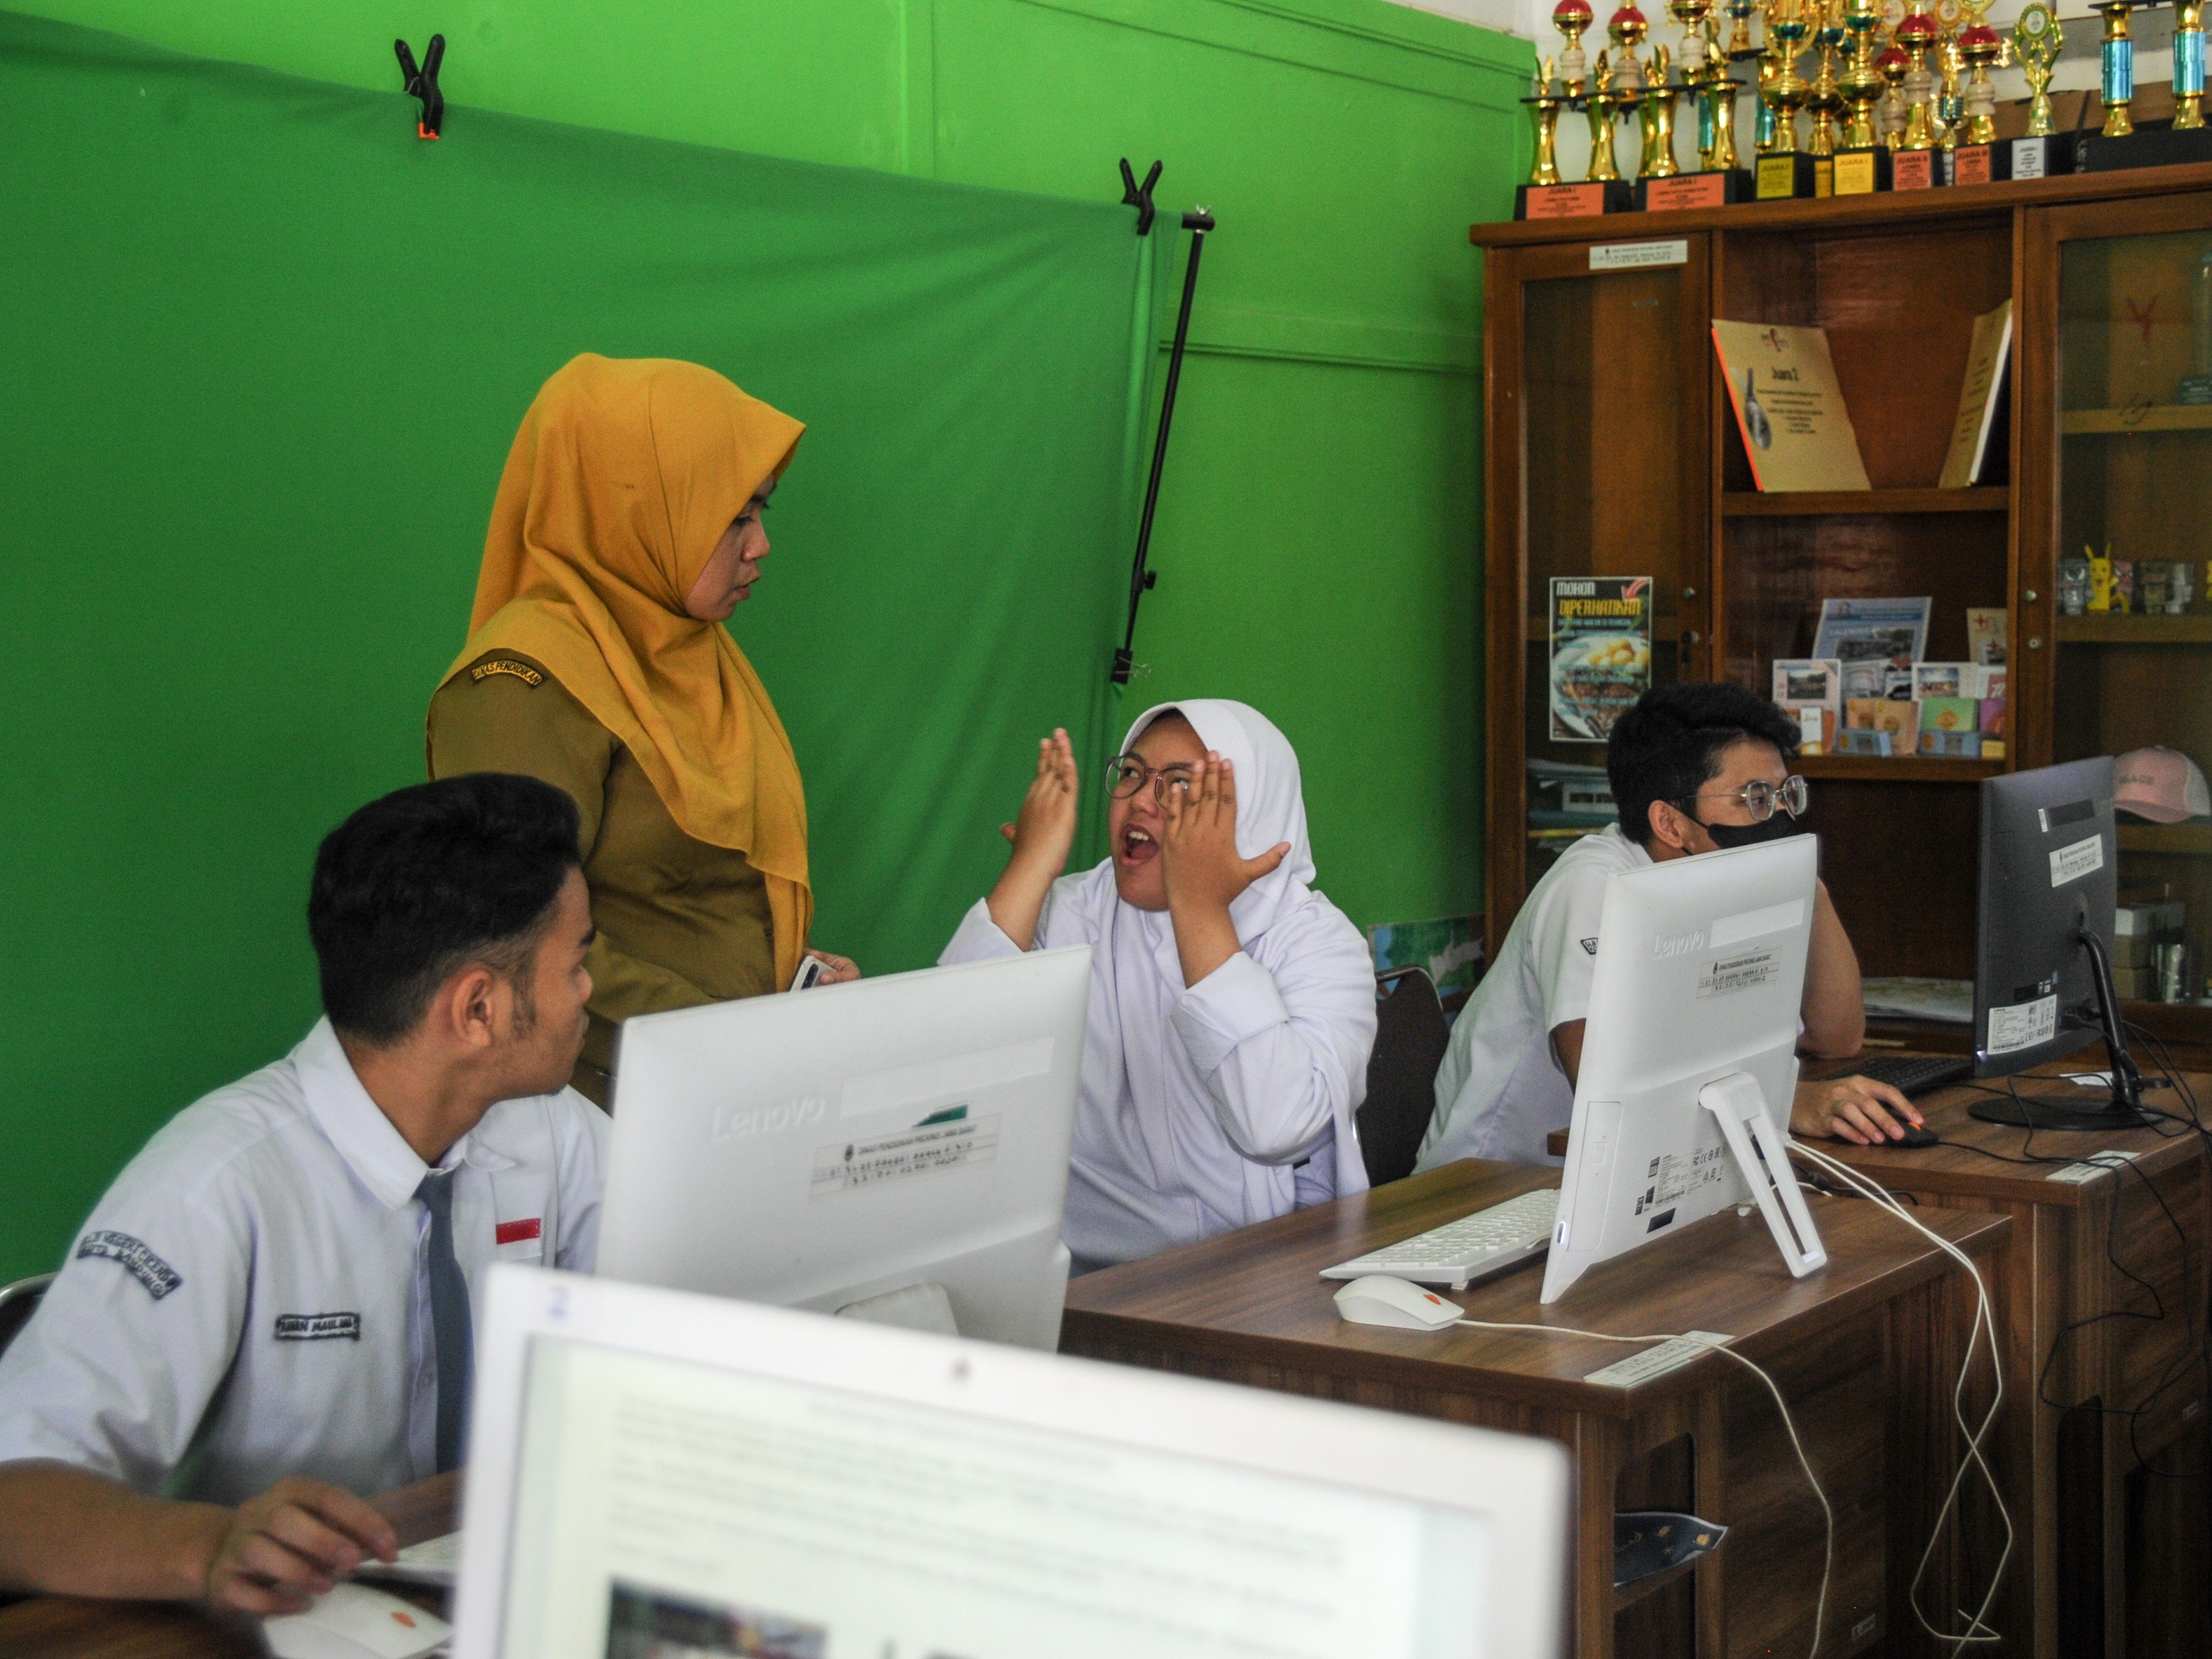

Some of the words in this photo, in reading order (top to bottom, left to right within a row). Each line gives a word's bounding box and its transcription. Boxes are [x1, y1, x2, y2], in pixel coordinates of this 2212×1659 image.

[1556, 581, 1596, 596] MOHON
[473, 662, 494, 678] DINAS
[496, 661, 540, 685] PENDIDIKAN
